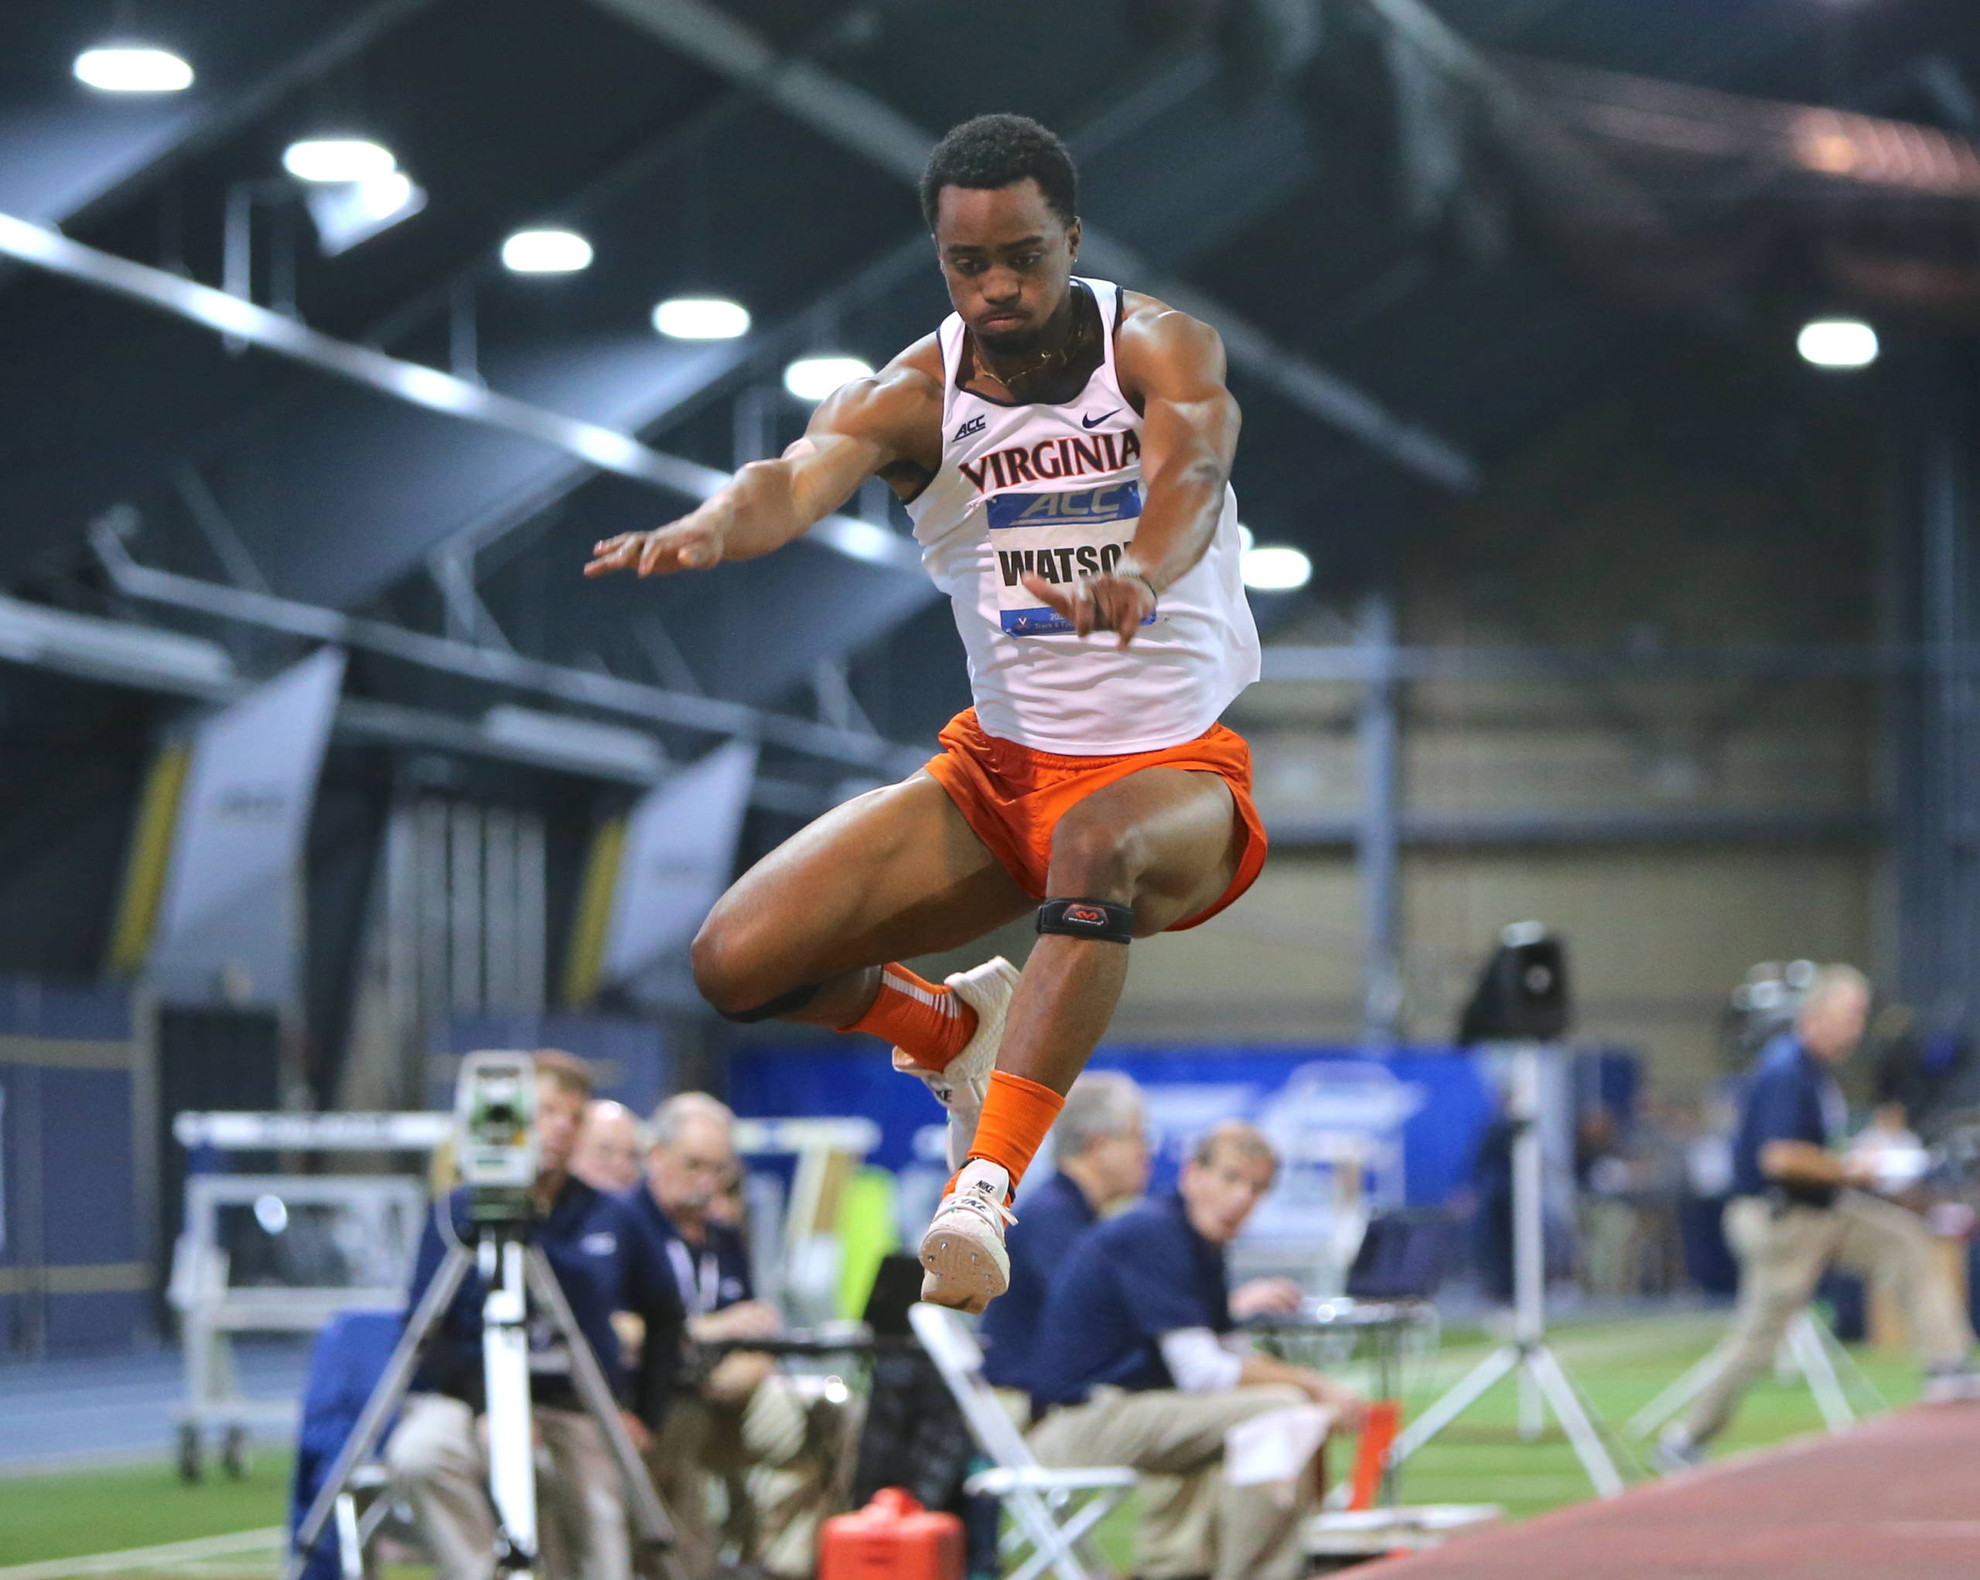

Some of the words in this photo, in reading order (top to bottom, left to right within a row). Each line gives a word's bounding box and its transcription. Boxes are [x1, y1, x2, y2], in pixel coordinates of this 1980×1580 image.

[951, 414, 986, 442] ACC
[958, 428, 1141, 494] VIRGINIA
[1011, 482, 1122, 525] ACC
[999, 541, 1132, 586] WATSO
[975, 1180, 995, 1193] NIKE
